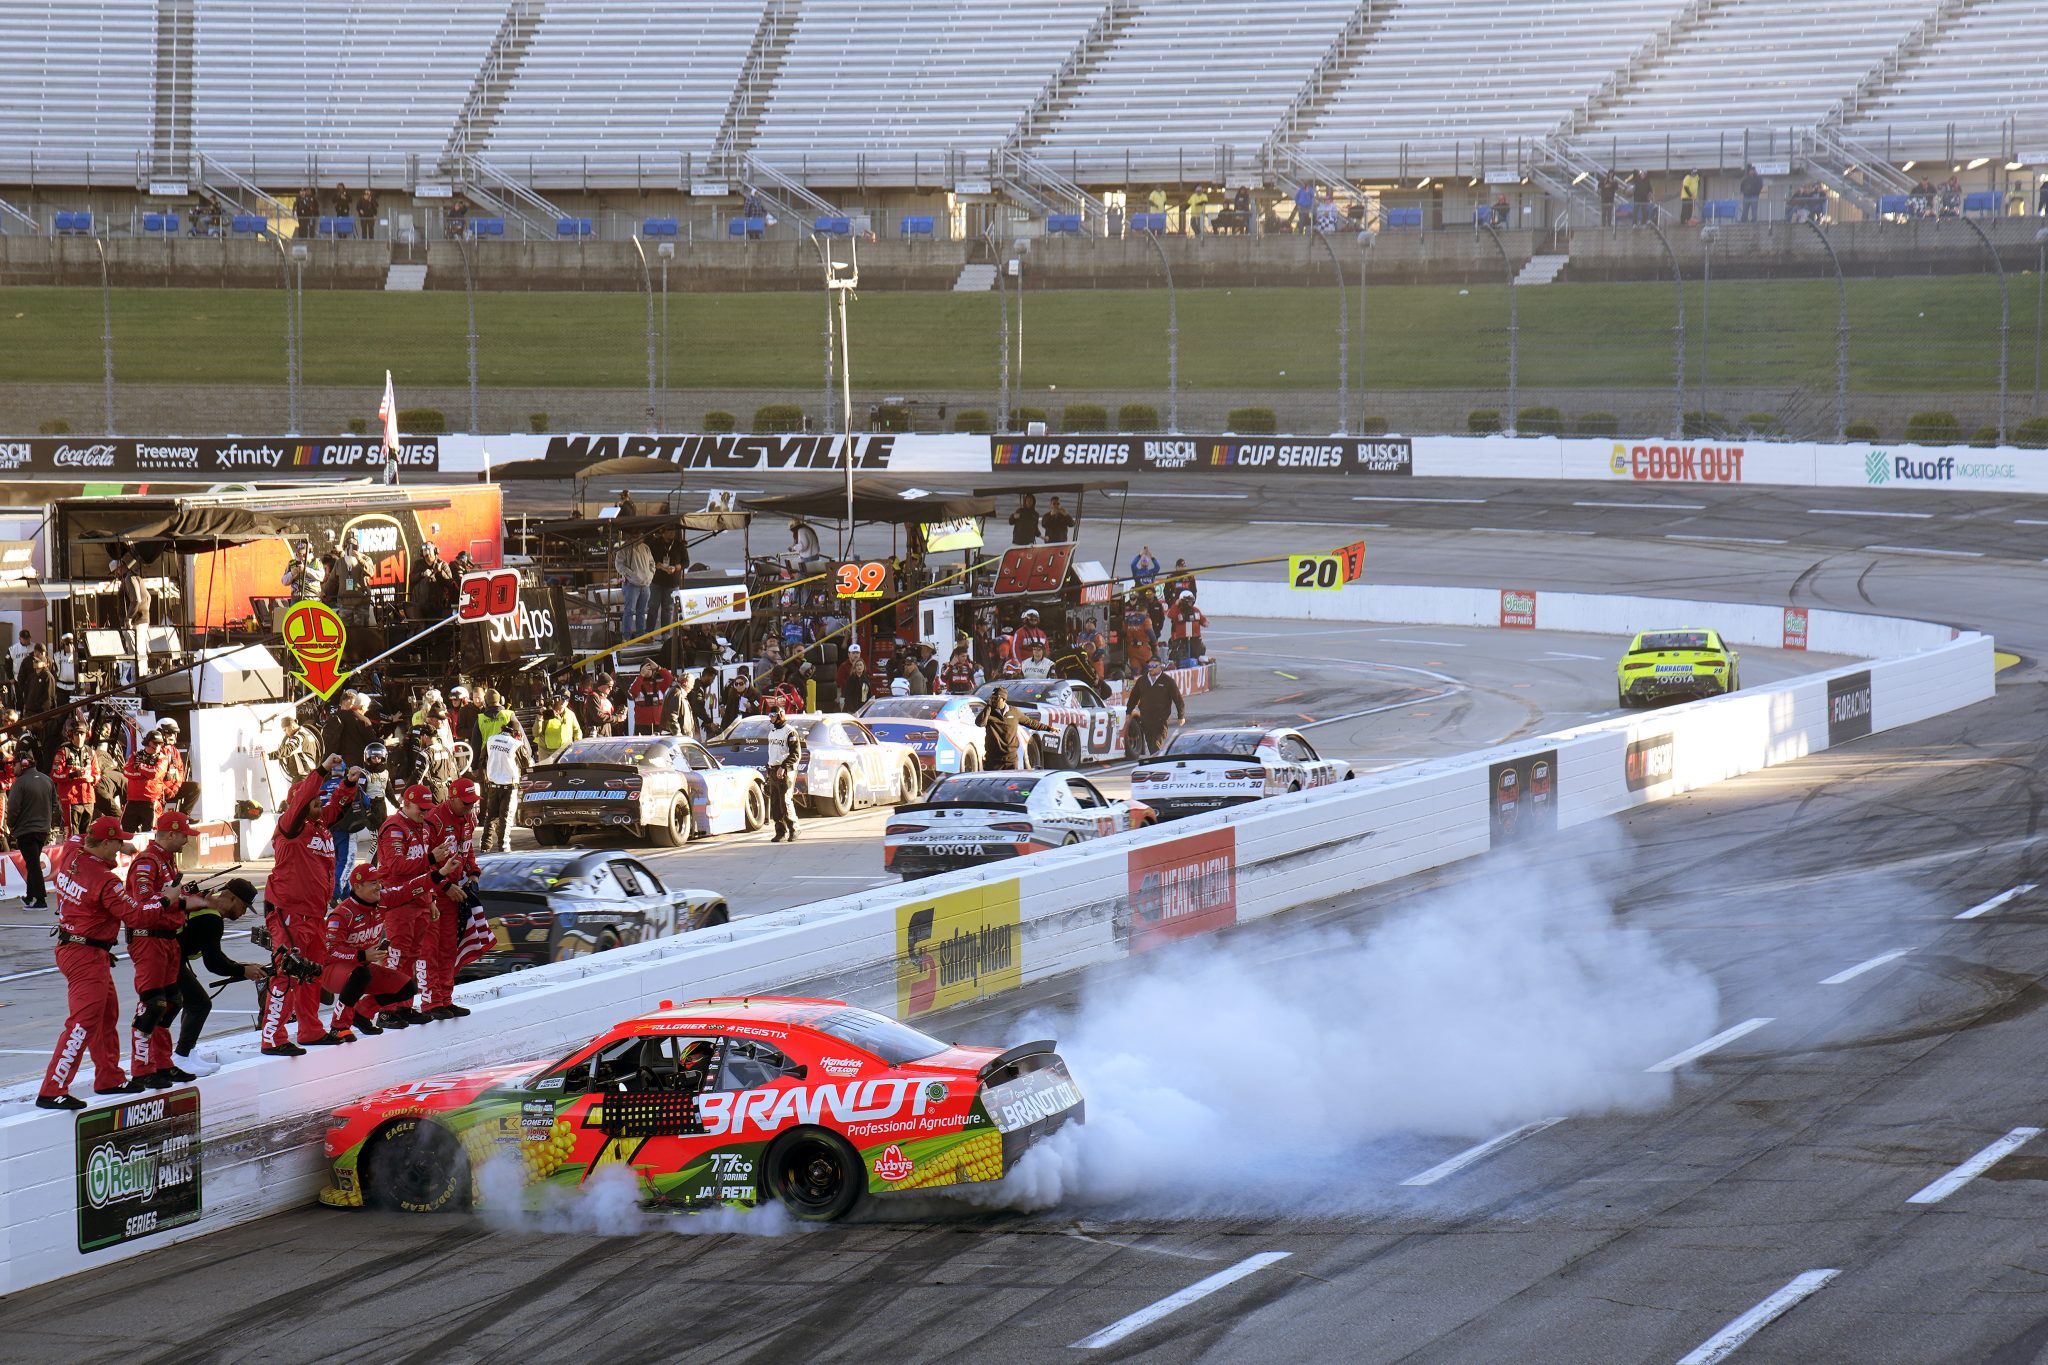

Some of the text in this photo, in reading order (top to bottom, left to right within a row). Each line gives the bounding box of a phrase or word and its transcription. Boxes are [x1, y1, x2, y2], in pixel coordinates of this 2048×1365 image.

[0, 443, 31, 462] SCH
[53, 444, 117, 466] Coca-Cola
[136, 444, 198, 462] Freeway
[216, 446, 283, 469] xfinity
[322, 445, 436, 466] CUP SEIES
[544, 436, 896, 469] MARTINSVILLE
[1021, 443, 1130, 465] CUP SERIES
[1144, 441, 1197, 462] BUSCH
[1238, 445, 1343, 467] CUP SERIES
[1357, 442, 1409, 463] BUSCH
[0, 460, 20, 469] GHT
[136, 460, 199, 468] INSURANCE
[1152, 459, 1186, 468] LIGHT
[1366, 461, 1400, 471] LIGHT
[1632, 446, 1745, 482] COOK OUT
[1895, 456, 2015, 480] Ruoff MORTGAGE
[835, 562, 886, 594] 39
[1296, 558, 1338, 587] 20
[461, 574, 518, 620] 30
[1656, 674, 1695, 684] TOYOTA
[1089, 711, 1112, 754] 8
[627, 790, 640, 800] 9
[1249, 780, 1263, 789] 30
[1015, 833, 1029, 843] 18
[926, 844, 985, 856] TOYOTA
[1161, 855, 1230, 920] WEAVER MEDIA
[347, 921, 385, 944] BRAND
[735, 1026, 789, 1040] REGISTIX
[51, 1023, 88, 1089] BRANDT
[819, 1056, 864, 1068] Hendrick
[825, 1065, 859, 1075] Cars.com
[126, 1099, 165, 1128] NASCAR
[678, 1076, 957, 1139] BRANDT
[385, 1122, 416, 1140] EAGLE
[521, 1118, 554, 1127] COMETIC
[847, 1122, 917, 1137] Professional
[161, 1134, 190, 1163] AUTO
[89, 1149, 158, 1201] O'Reilly
[158, 1157, 193, 1190] PARTS
[874, 1157, 914, 1172] Arby's
[696, 1185, 753, 1199] JARETT
[125, 1210, 158, 1238] SERIES
